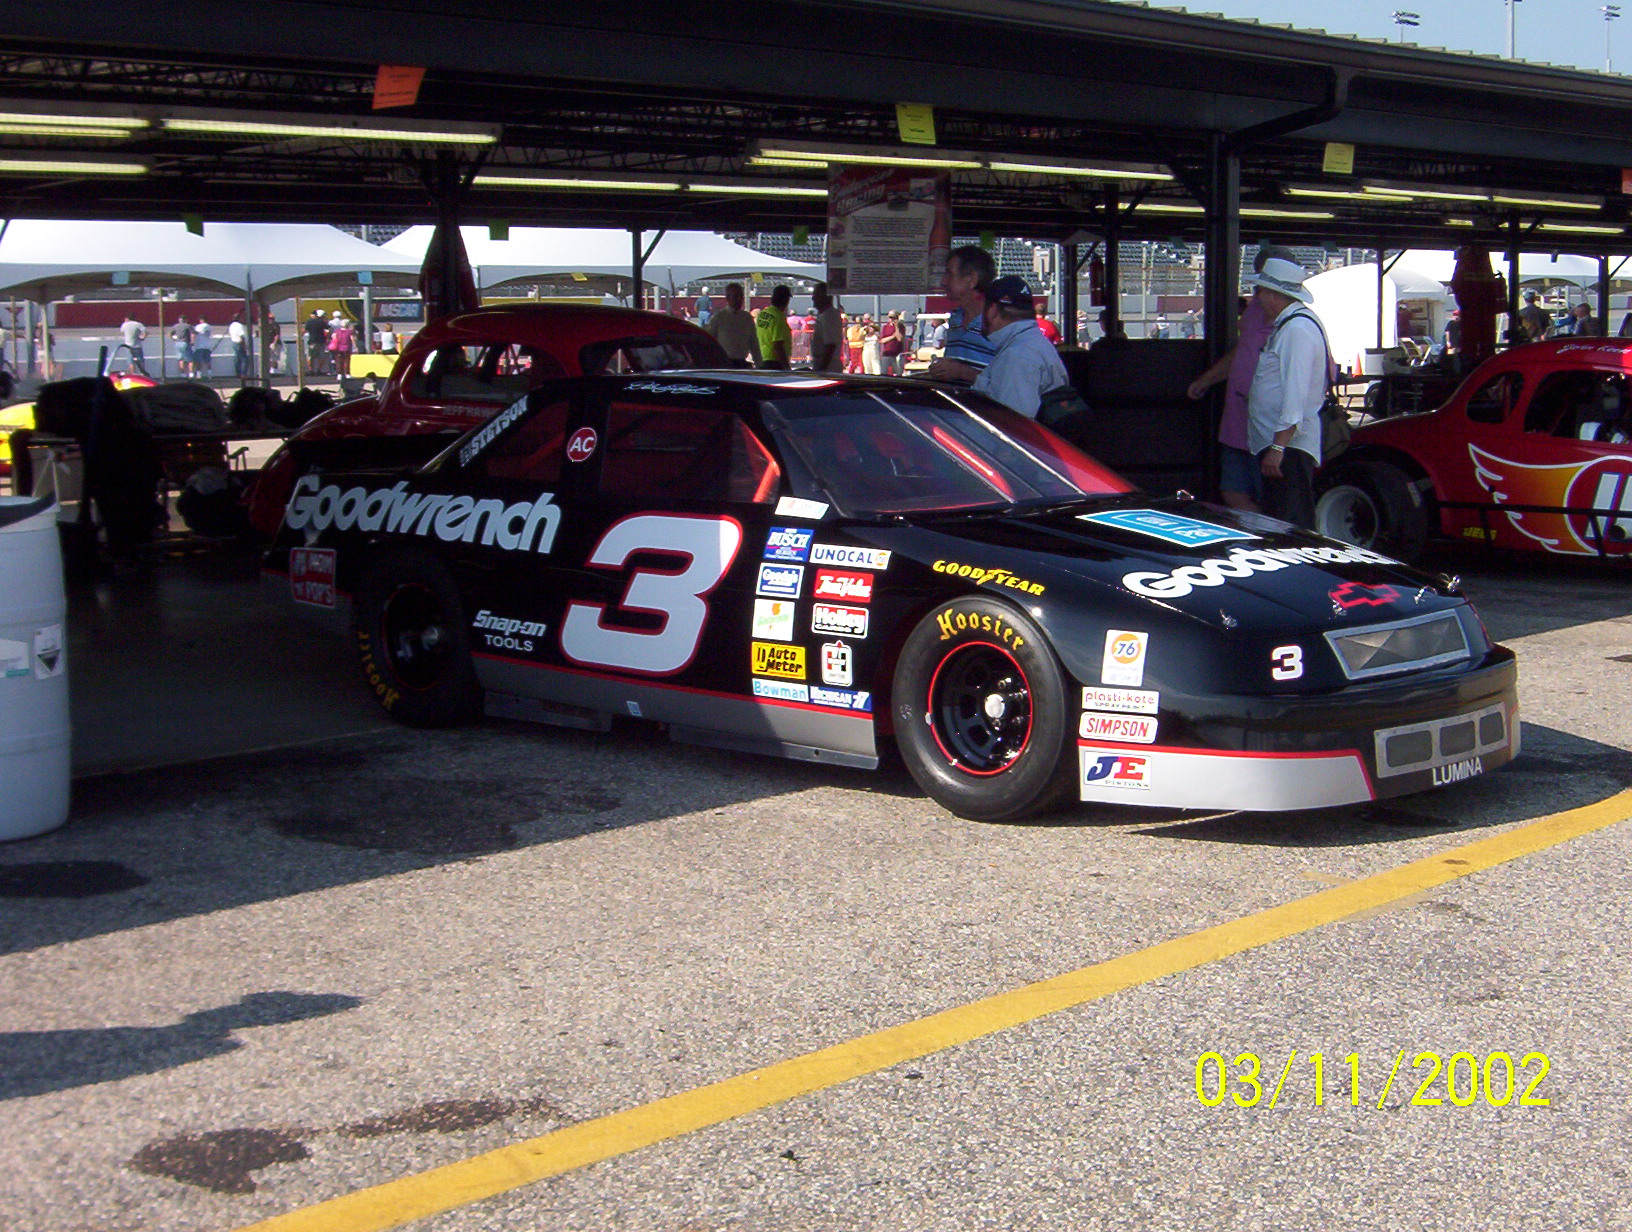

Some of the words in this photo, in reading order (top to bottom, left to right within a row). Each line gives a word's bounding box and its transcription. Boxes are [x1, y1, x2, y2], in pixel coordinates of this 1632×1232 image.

[569, 436, 595, 453] AC
[285, 474, 562, 554] Goodwrench
[766, 532, 811, 548] BUSCH
[814, 547, 873, 564] UNOCAL
[561, 511, 743, 676] 3
[472, 609, 547, 637] Snap-on
[816, 606, 866, 634] Holley
[936, 608, 1025, 651] Hoosier
[484, 634, 534, 652] TOOLS
[1116, 642, 1136, 657] 76
[768, 647, 797, 661] Auto
[1271, 645, 1304, 681] 3
[766, 659, 803, 673] Meter
[754, 680, 808, 700] Bowman
[1086, 717, 1150, 738] SIMPSON
[1086, 756, 1147, 782] JE
[1432, 756, 1483, 786] LUMINA
